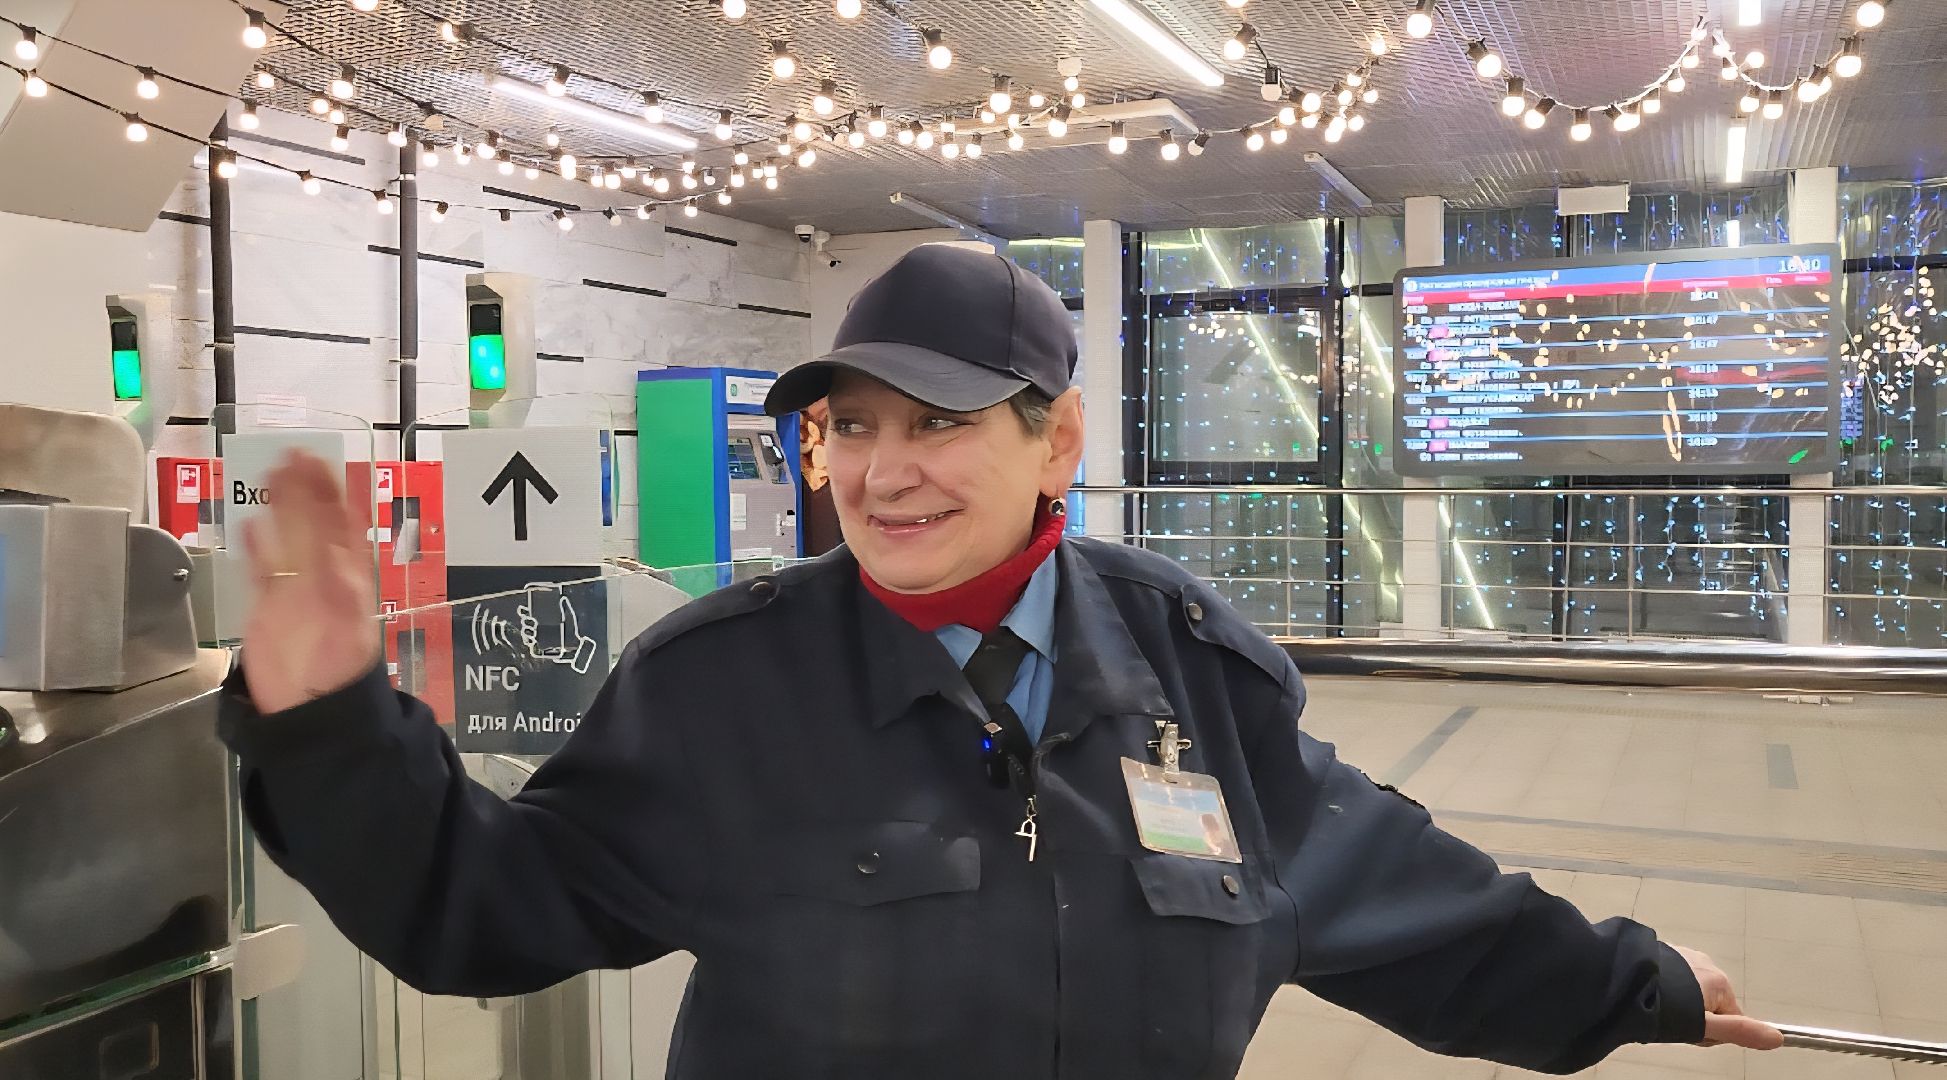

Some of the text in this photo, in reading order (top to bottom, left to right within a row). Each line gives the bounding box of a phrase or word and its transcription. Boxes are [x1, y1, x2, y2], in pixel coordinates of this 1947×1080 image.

[233, 480, 271, 505] Вхо
[465, 664, 520, 692] NFC
[467, 711, 581, 734] для Androi
